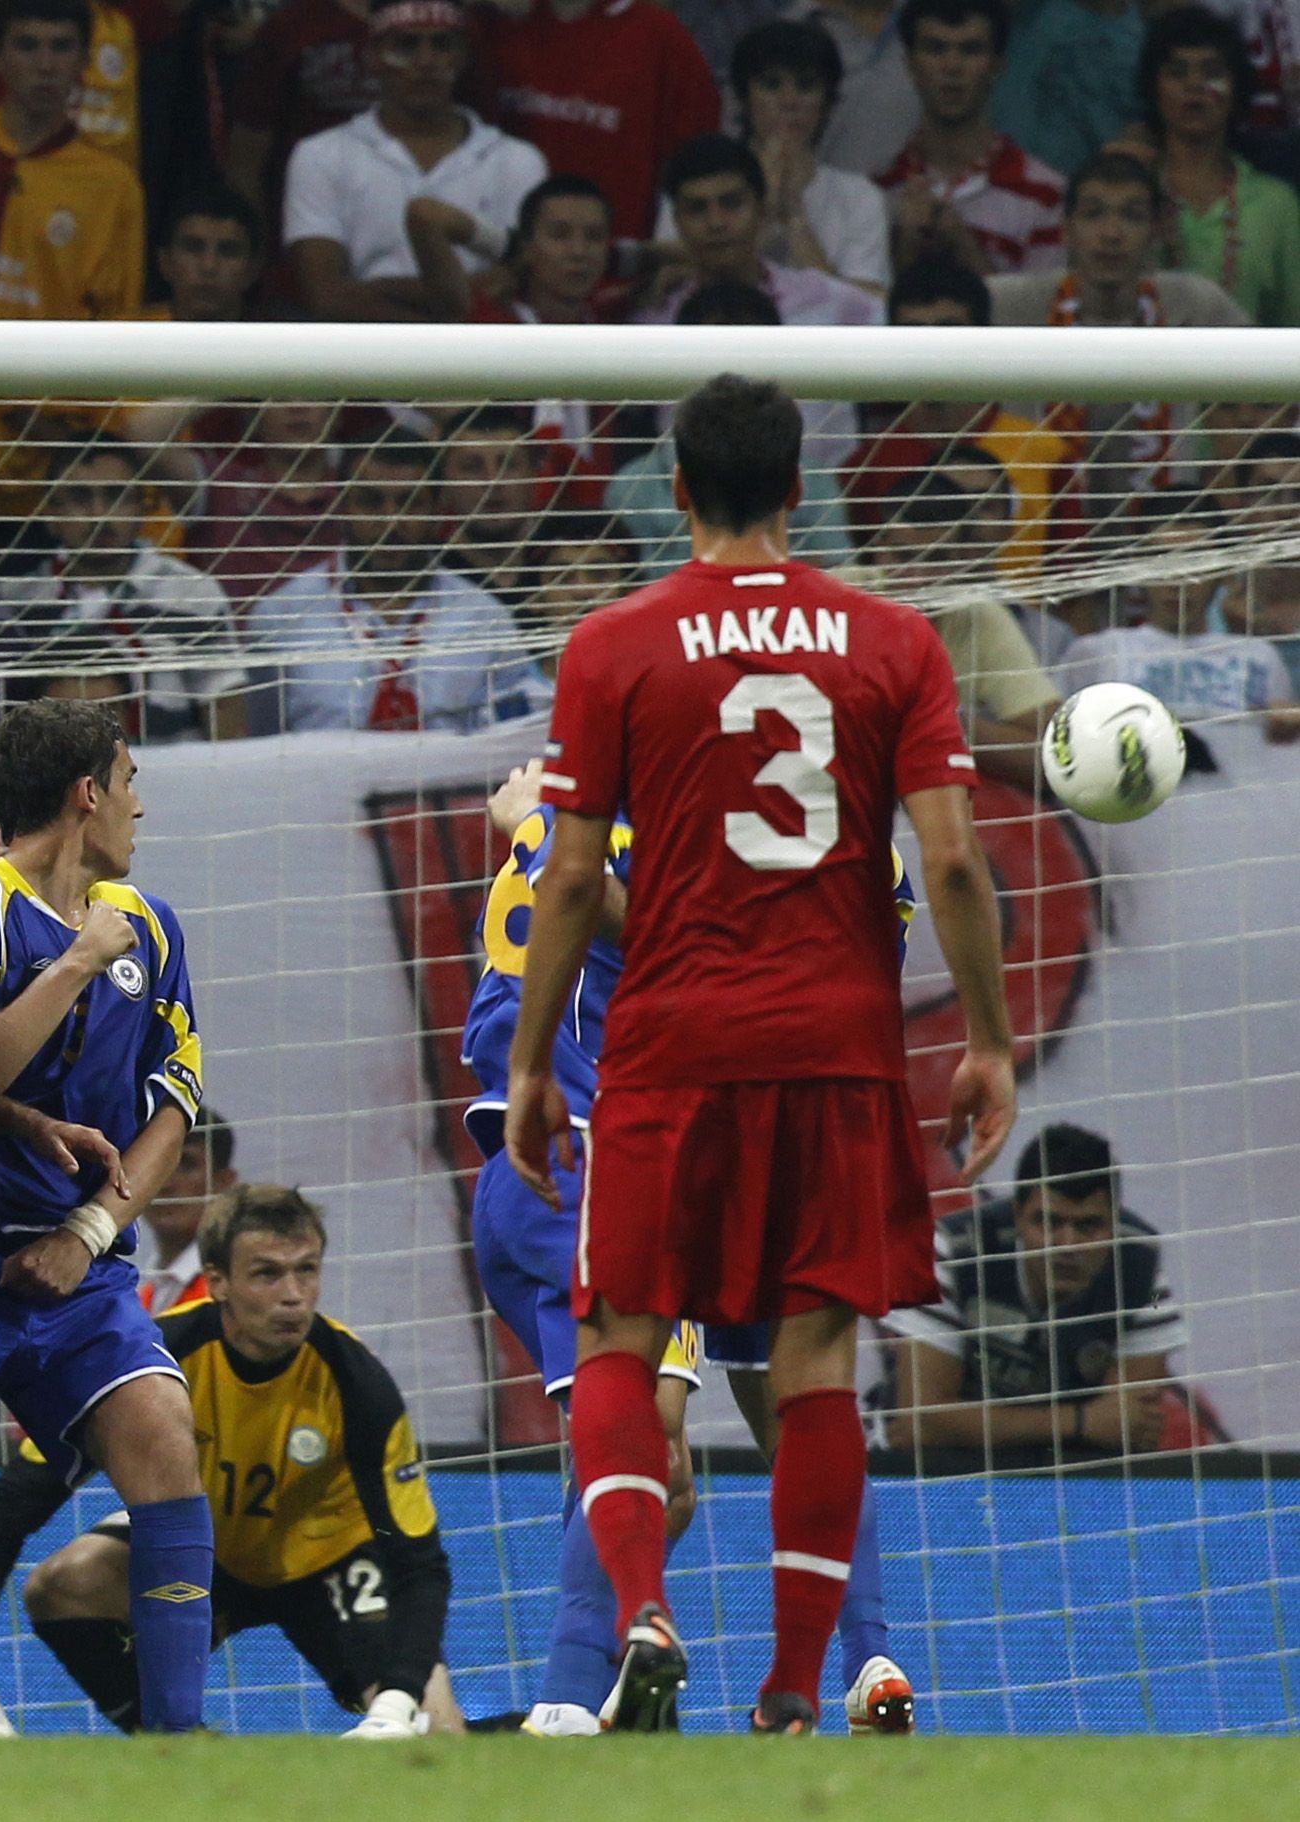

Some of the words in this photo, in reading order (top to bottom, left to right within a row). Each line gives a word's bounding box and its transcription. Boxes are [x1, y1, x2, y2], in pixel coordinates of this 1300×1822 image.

[676, 606, 849, 663] HAKAN
[718, 672, 840, 871] 3
[219, 1461, 277, 1519] 12
[324, 1558, 388, 1621] 12
